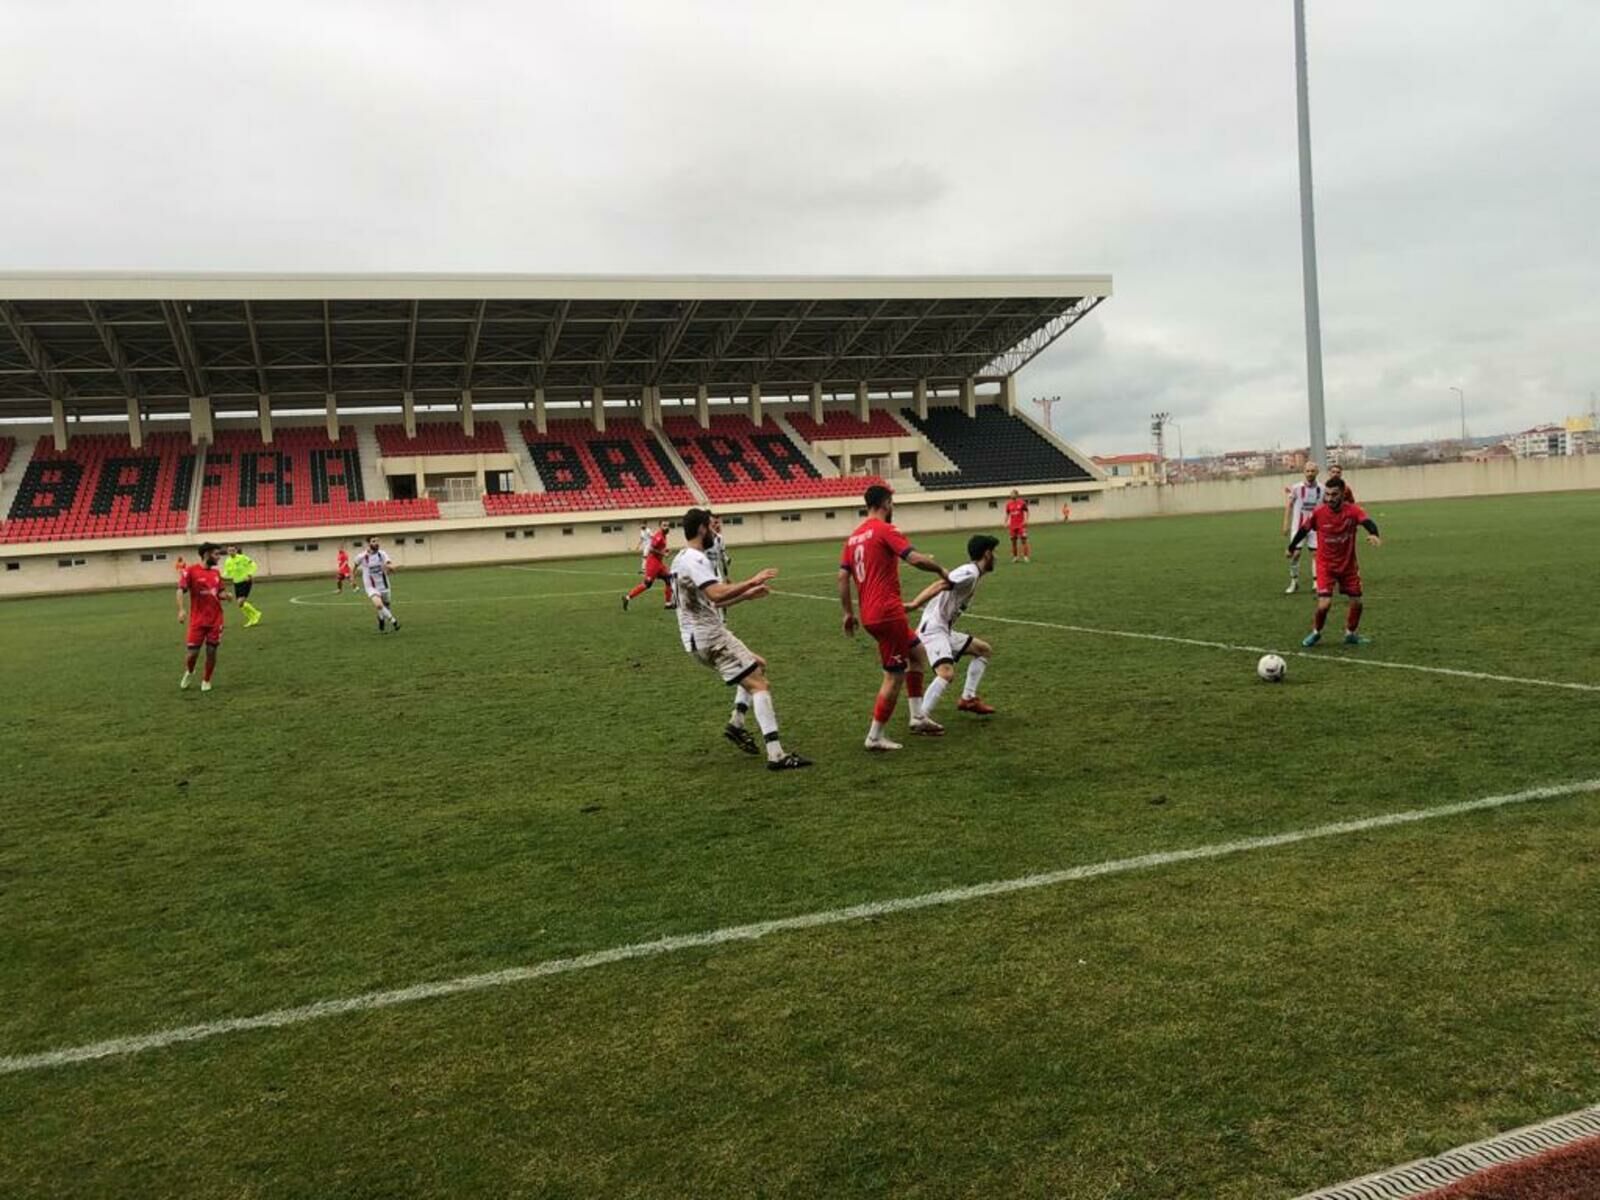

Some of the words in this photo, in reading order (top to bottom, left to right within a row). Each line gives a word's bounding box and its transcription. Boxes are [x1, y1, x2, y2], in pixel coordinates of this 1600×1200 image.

[7, 449, 365, 520] BAFRA
[526, 433, 822, 491] BAFRA
[854, 544, 866, 583] 8
